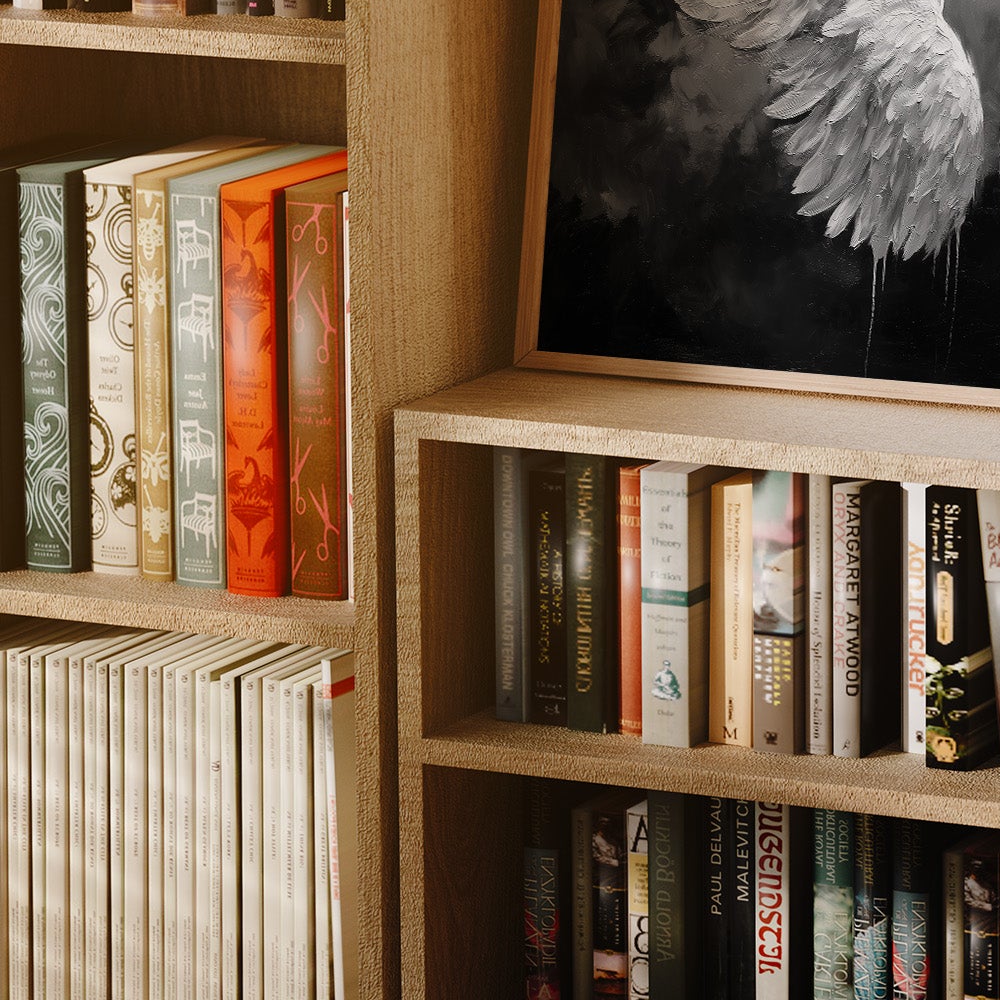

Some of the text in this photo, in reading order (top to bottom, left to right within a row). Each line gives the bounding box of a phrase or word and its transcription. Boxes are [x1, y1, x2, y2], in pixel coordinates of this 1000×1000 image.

[501, 454, 513, 690] DOWNTOWN OWL CHUCK KLOSTERMAN
[651, 537, 682, 548] Theory
[833, 492, 845, 668] ORYX AND CRAKE
[845, 492, 860, 696] MARGARET ATWOOD
[811, 591, 822, 739] House of Splendid Isolation
[908, 605, 925, 696] rucker
[710, 797, 722, 915] PAUL DELVAU
